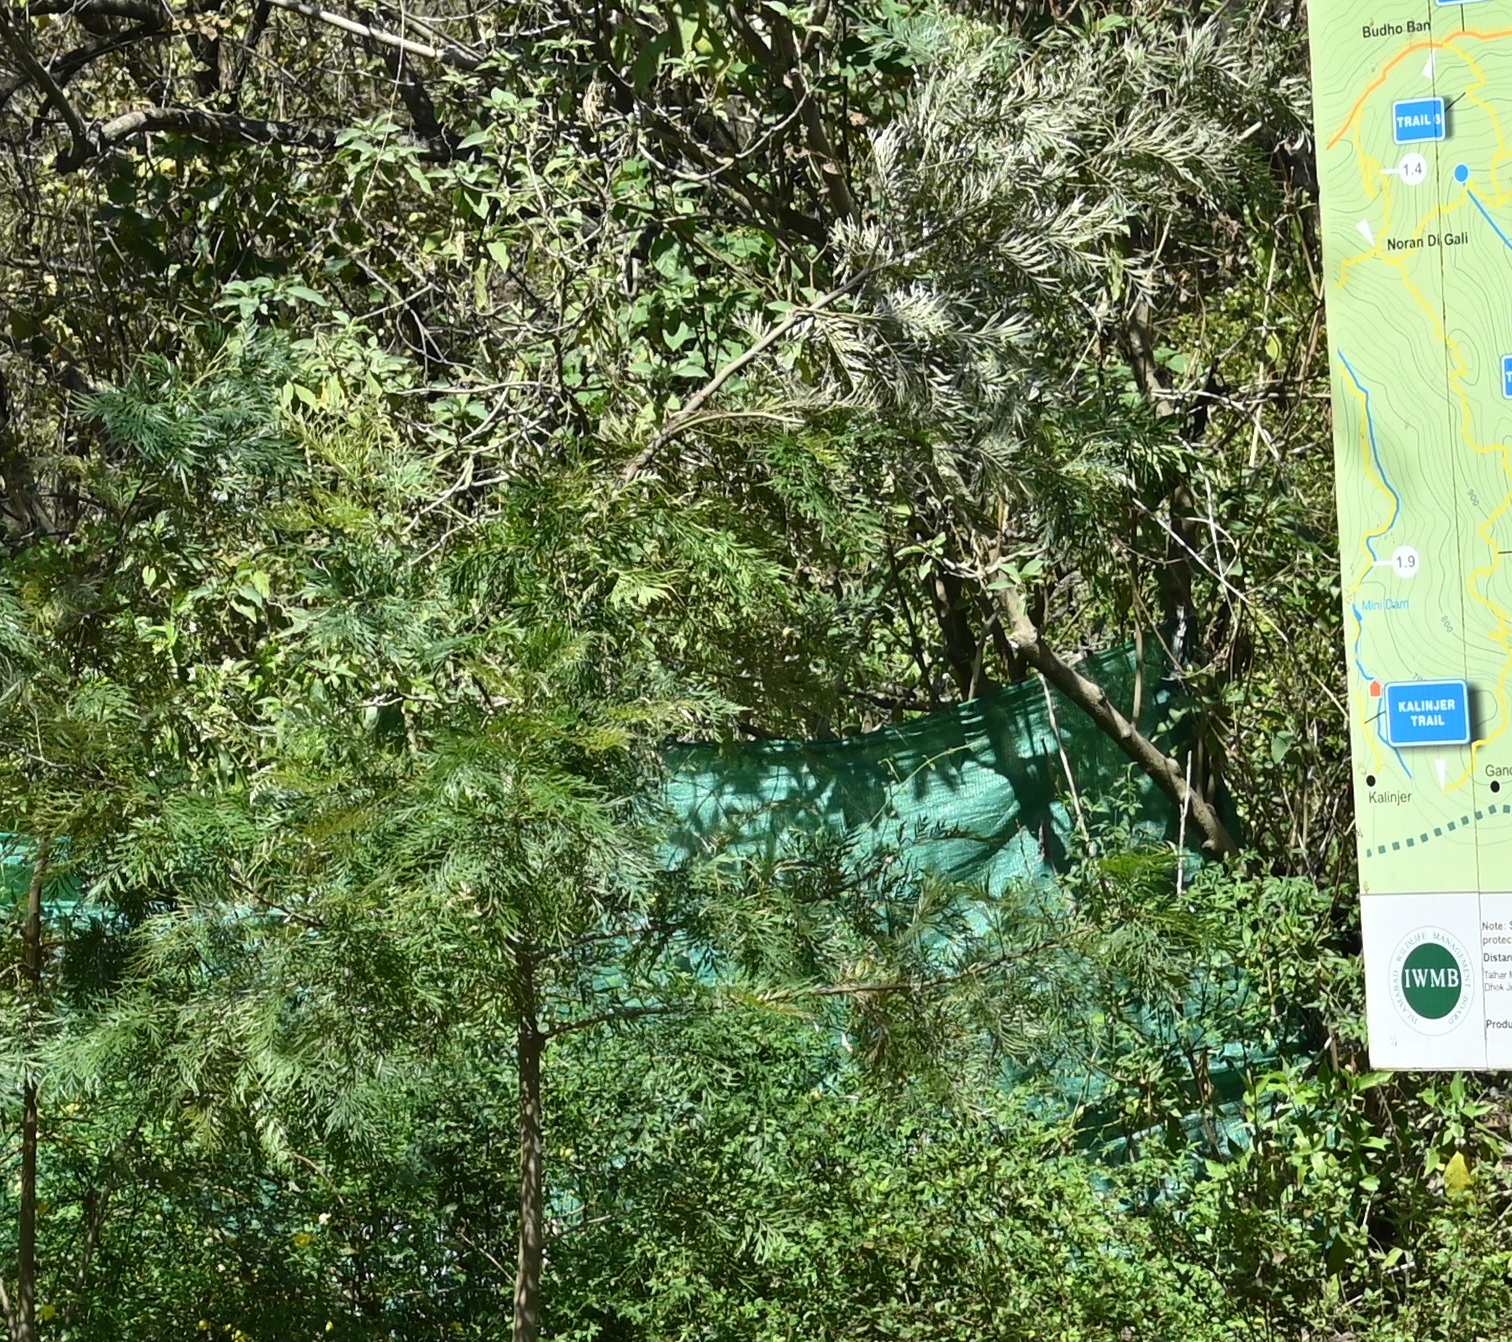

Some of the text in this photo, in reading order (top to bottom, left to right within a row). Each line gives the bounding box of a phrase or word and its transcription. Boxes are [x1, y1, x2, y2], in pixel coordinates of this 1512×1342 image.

[1362, 21, 1431, 38] Budho Ban
[1397, 112, 1431, 127] TRAIL
[1403, 162, 1422, 175] 1.4
[1387, 232, 1468, 250] Noran Di Gali
[1397, 556, 1415, 568] 1.9
[1398, 699, 1455, 712] KALINJER
[1411, 714, 1445, 726] TRAIL
[1369, 791, 1412, 805] Kalinjer
[1405, 968, 1459, 988] IWMB
